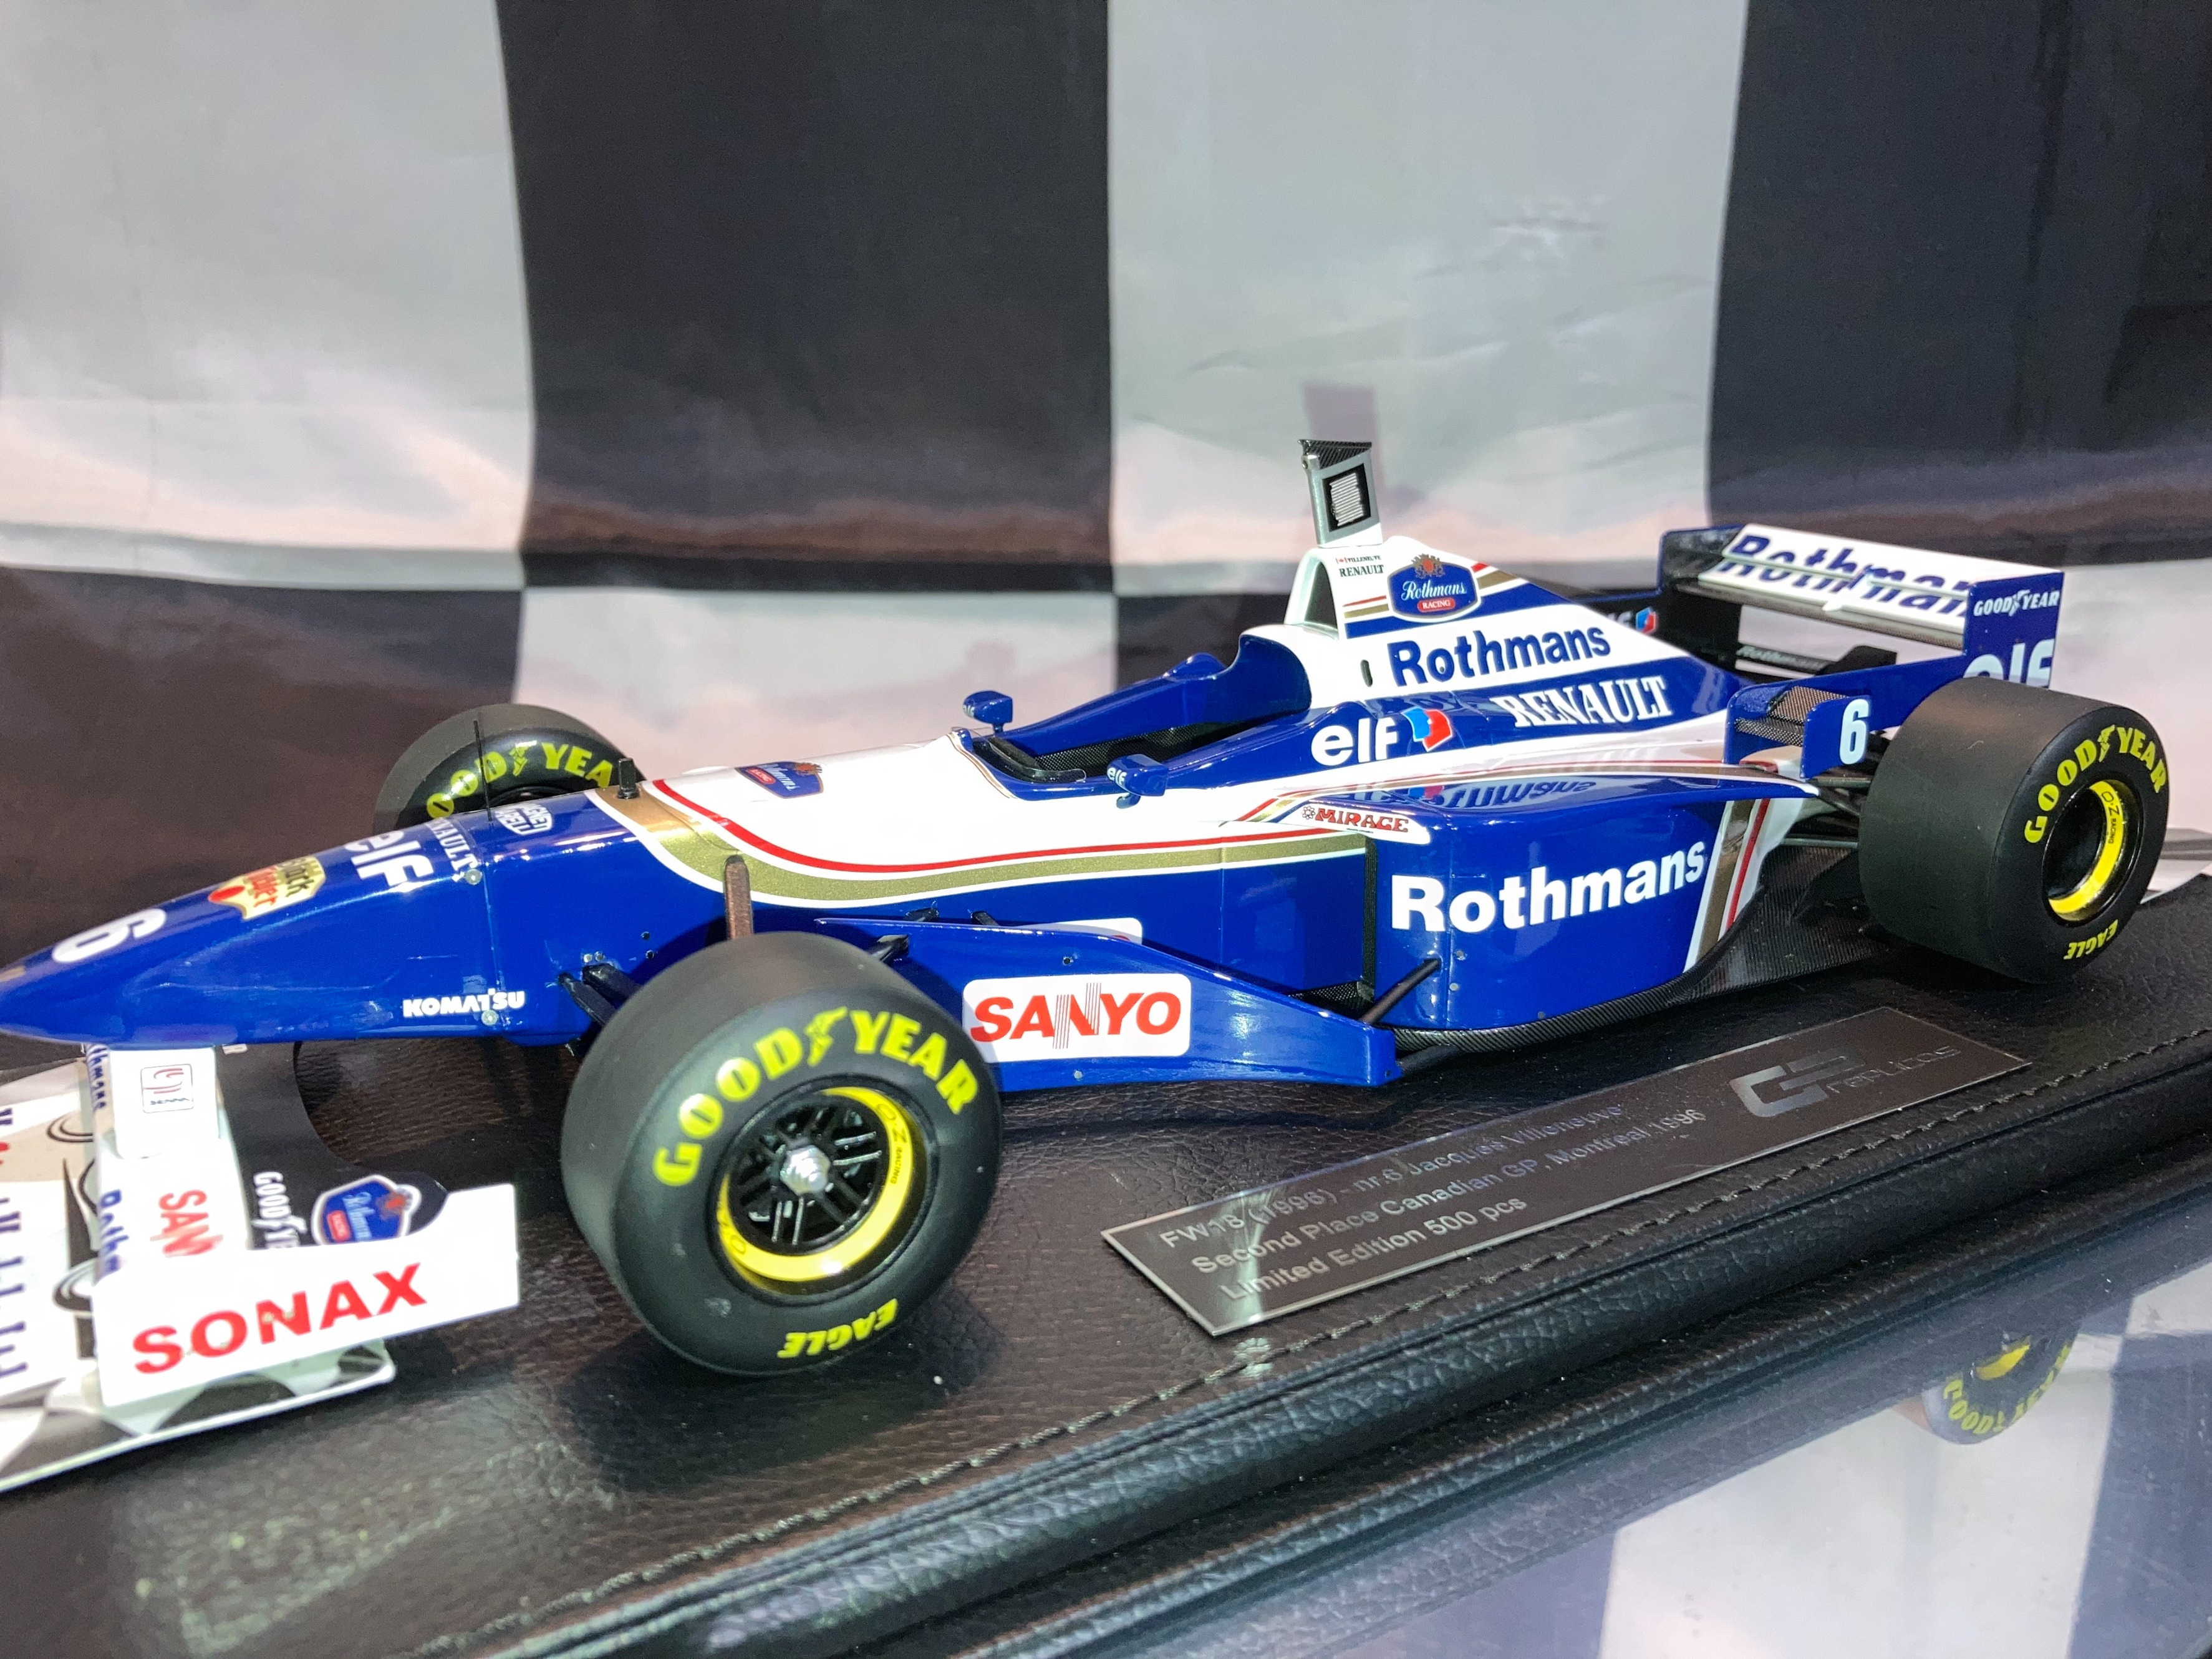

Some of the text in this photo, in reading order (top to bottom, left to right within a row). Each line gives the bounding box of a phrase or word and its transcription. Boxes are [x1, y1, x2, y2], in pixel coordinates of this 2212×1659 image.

[1339, 564, 1384, 577] RENAULT
[1401, 579, 1466, 601] Rothmans
[1422, 599, 1451, 609] RACING
[1387, 626, 1611, 687] Rothmans
[1490, 675, 1671, 728] RENAULT
[1838, 698, 1869, 765] 6
[1311, 717, 1399, 766] elf
[427, 741, 613, 819] OODYEA
[1107, 767, 1127, 785] elf
[1315, 808, 1409, 833] MIRAGE
[1391, 840, 1706, 934] Rothmans
[2063, 919, 2118, 960] EAGLE
[403, 988, 525, 1018] KOMATSU
[970, 982, 1181, 1049] SANYO
[890, 1146, 903, 1184] RACING
[1159, 1213, 1245, 1249] FW18
[1248, 1187, 1338, 1225] (1996)
[1408, 1139, 1507, 1176] Jacques
[1500, 1105, 1623, 1144] Villeneuve
[1192, 1232, 1302, 1274] Second
[1300, 1209, 1378, 1241] Place
[1380, 1168, 1500, 1216] Canadian
[1545, 1124, 1651, 1164] Montreal
[1648, 1109, 1706, 1132] 1996
[150, 1189, 223, 1259] SAN
[1219, 1197, 1527, 1300] Limited Edition 500 pcs
[133, 1263, 427, 1374] SONAX
[777, 1298, 898, 1358] EAGLE
